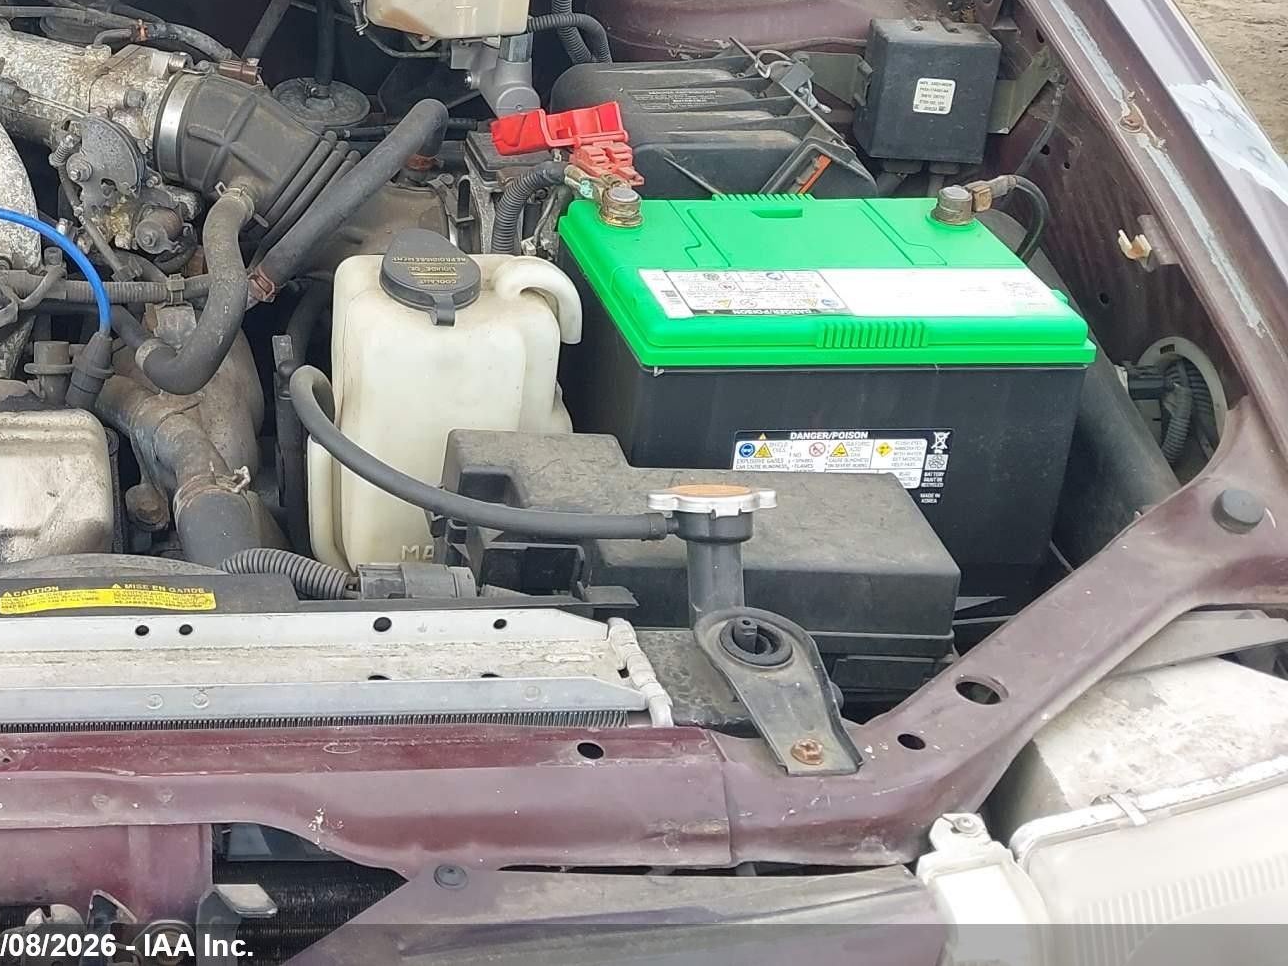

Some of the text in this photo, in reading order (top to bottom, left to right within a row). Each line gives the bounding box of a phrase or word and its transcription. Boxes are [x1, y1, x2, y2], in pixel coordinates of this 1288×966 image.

[789, 431, 869, 440] DANGER/POISON
[401, 544, 434, 562] MA
[13, 585, 59, 597] CAUTION
[123, 583, 205, 594] MISE EN GARDE
